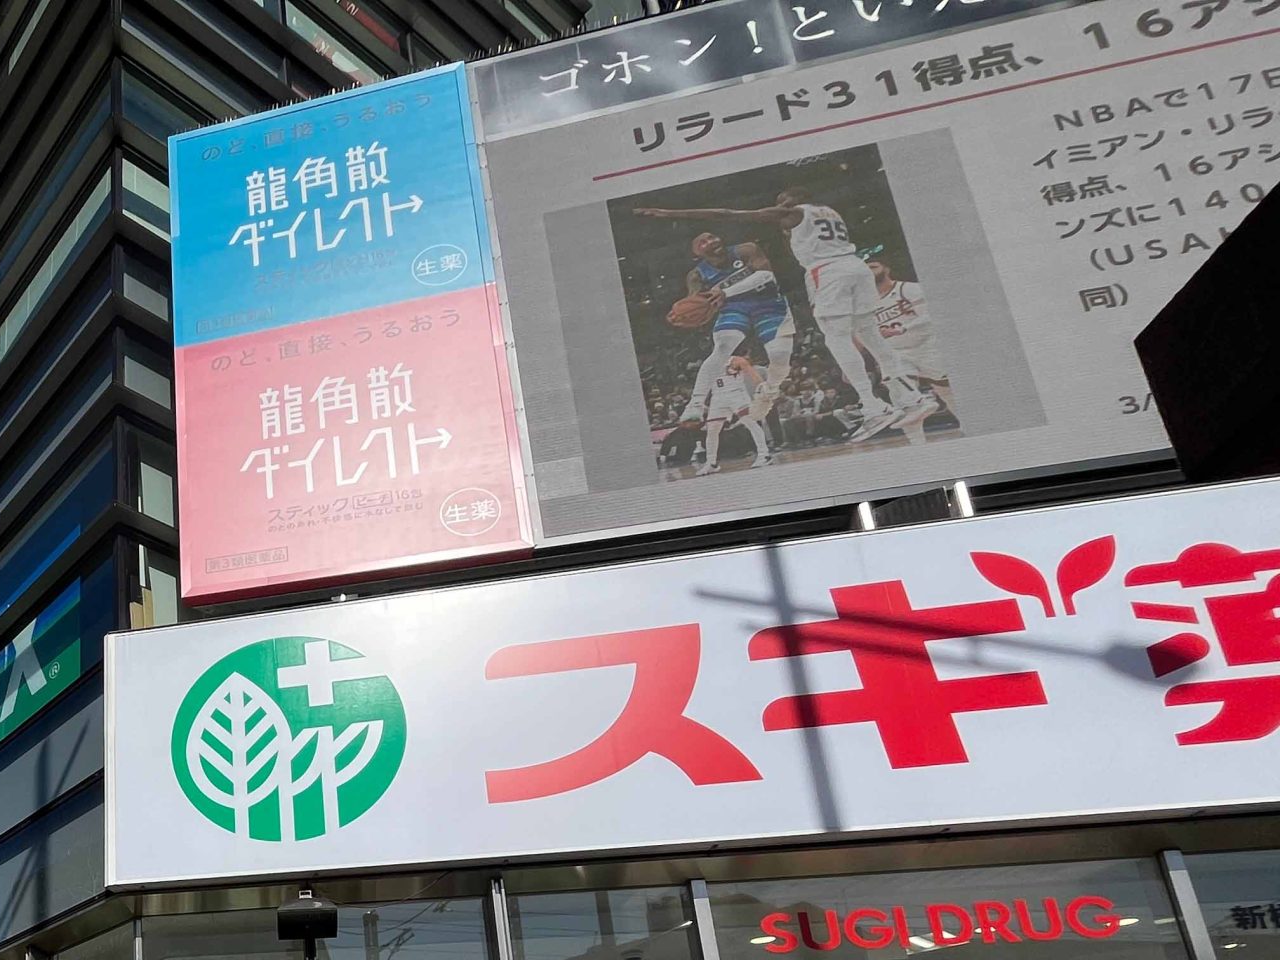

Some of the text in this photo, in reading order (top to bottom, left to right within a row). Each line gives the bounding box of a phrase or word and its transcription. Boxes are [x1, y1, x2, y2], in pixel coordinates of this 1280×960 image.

[245, 141, 390, 216] 龍角散
[228, 192, 423, 266] ダイレクト
[416, 253, 463, 276] 生薬
[259, 362, 416, 439] 龍角散
[240, 423, 453, 499] ダイレクト
[446, 501, 498, 525] 生薬
[760, 896, 1121, 953] SUGI DRUG
